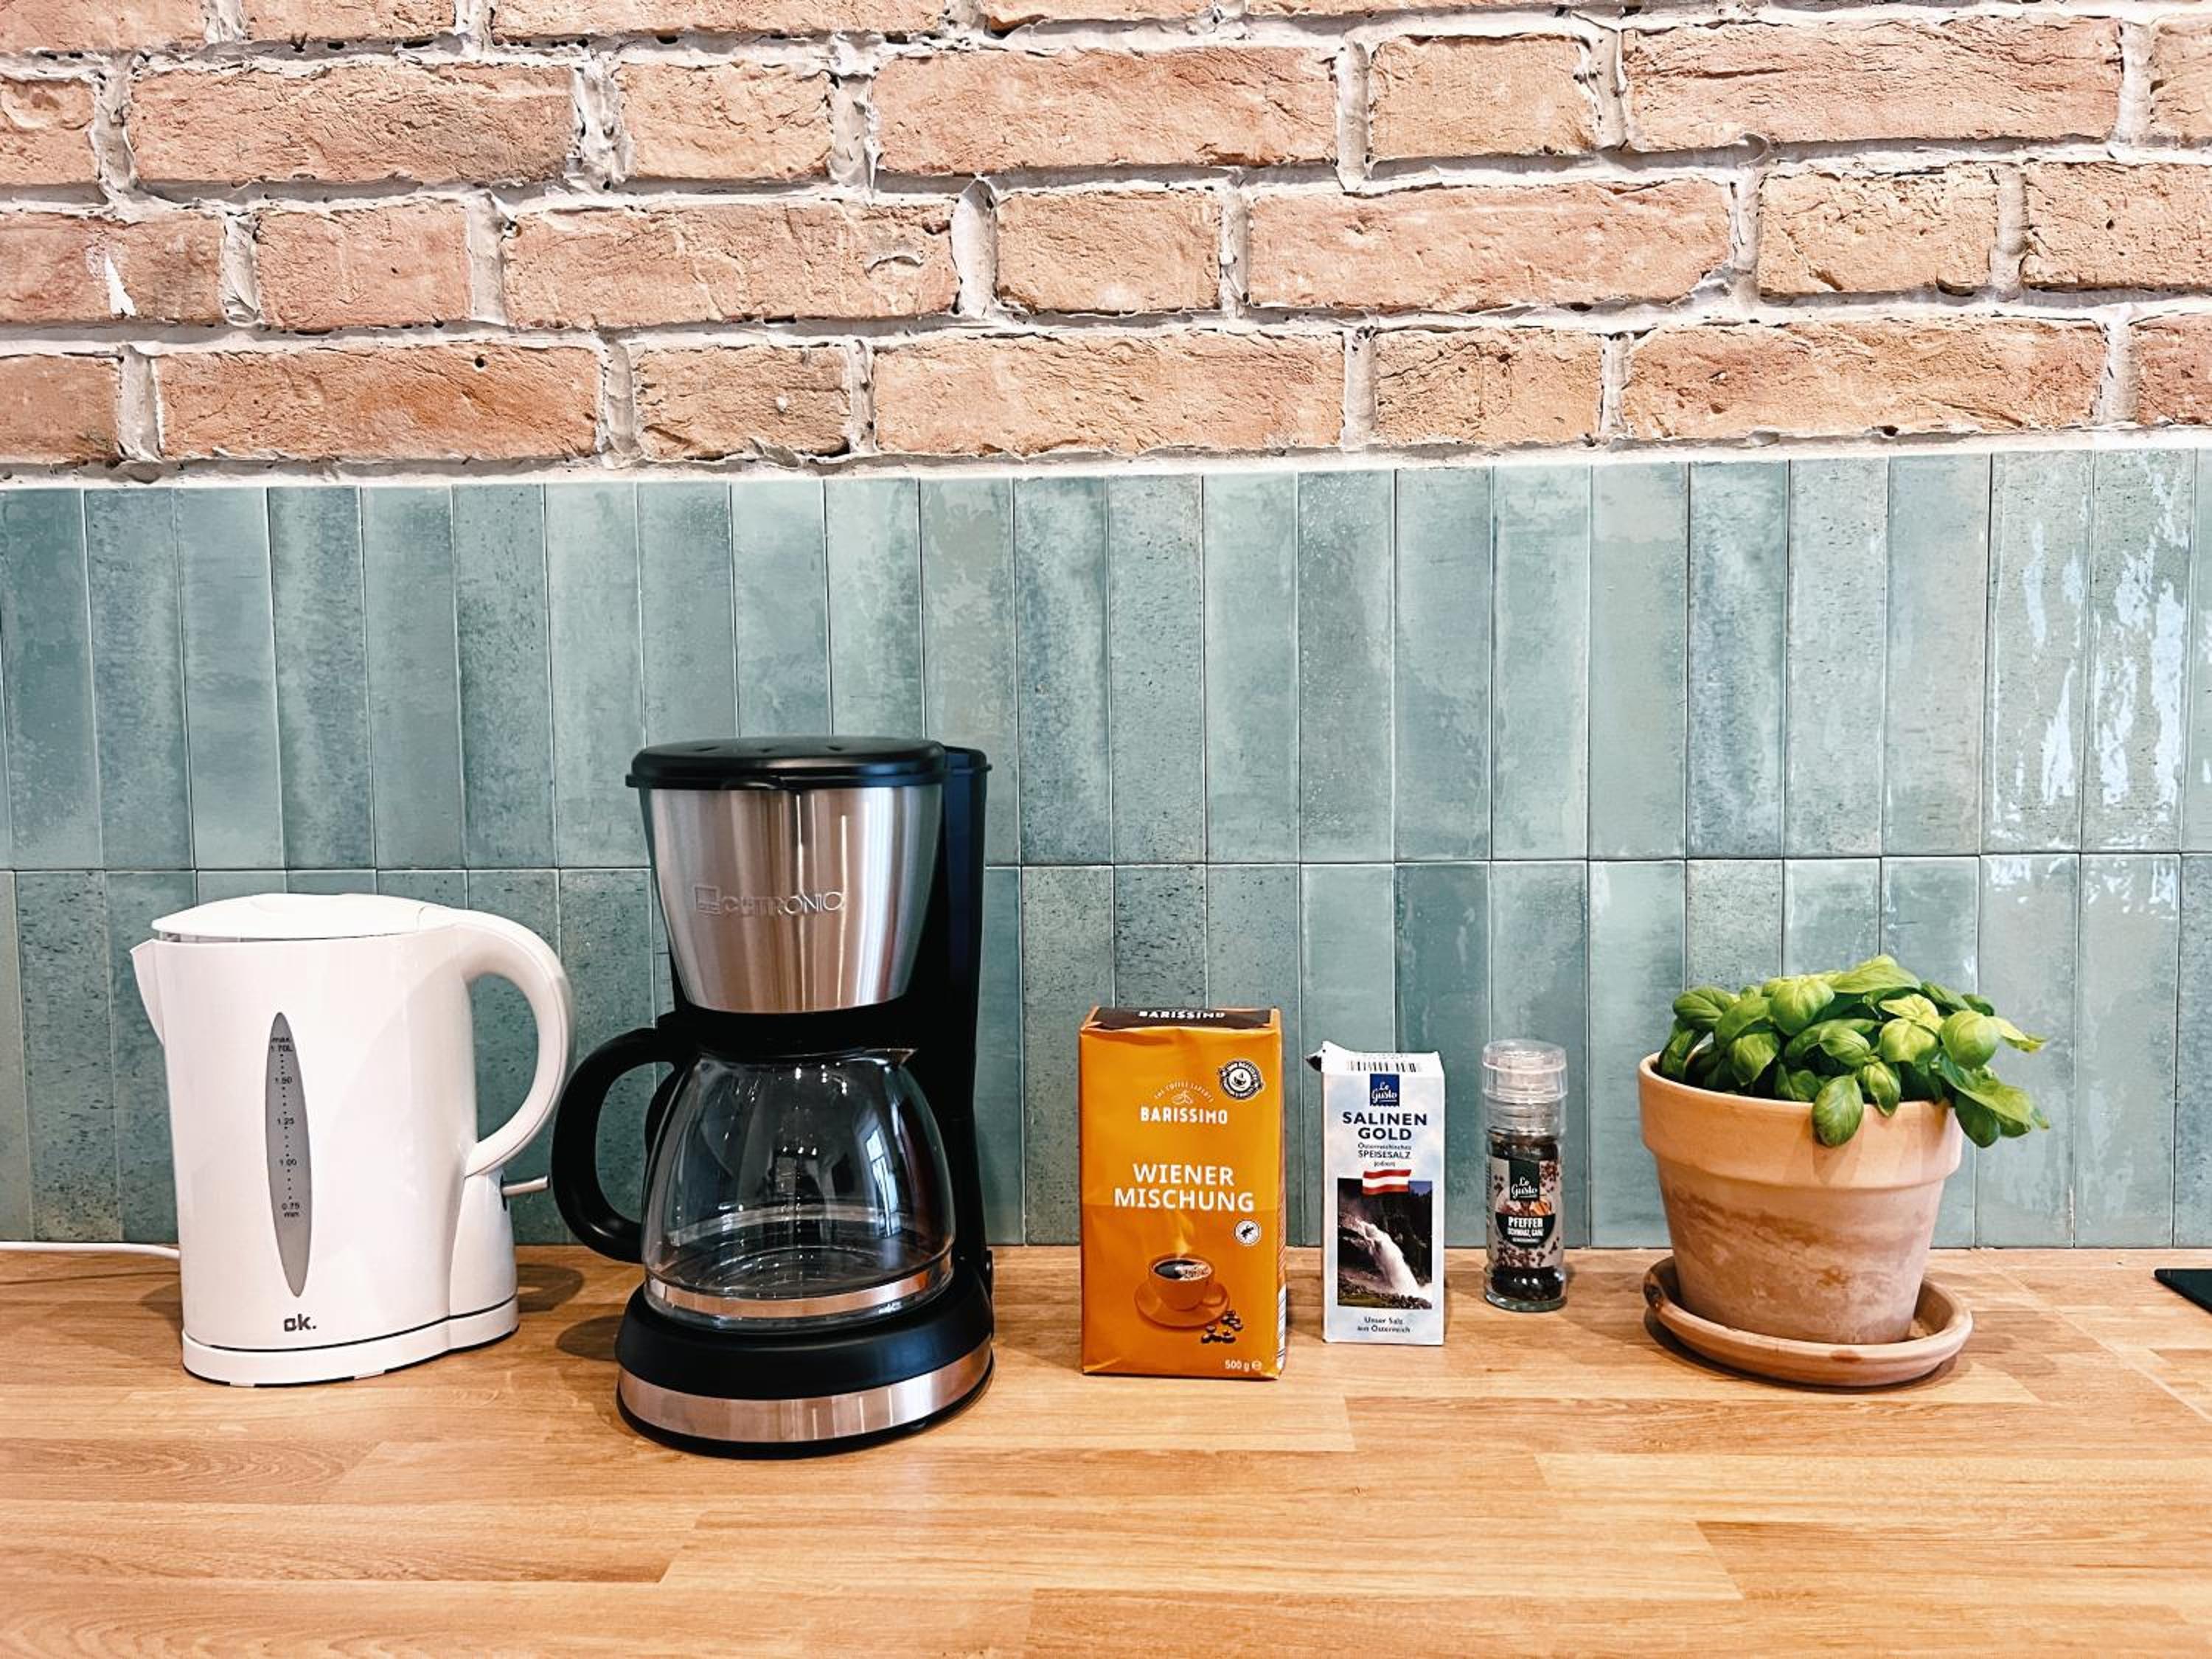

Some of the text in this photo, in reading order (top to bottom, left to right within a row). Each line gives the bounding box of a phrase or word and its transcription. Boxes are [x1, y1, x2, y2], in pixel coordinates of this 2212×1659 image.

[1371, 1082, 1397, 1104] Le Gusto
[1140, 1106, 1228, 1124] BARISSIMO
[1343, 1111, 1427, 1126] SALINEN
[1357, 1127, 1412, 1141] GOLD
[1357, 1150, 1411, 1159] SPEISESALZ
[1132, 1164, 1235, 1186] WIENER
[1512, 1176, 1538, 1199] Le Gusto
[1113, 1187, 1255, 1213] MISCHUNG
[1508, 1216, 1544, 1228] PFEFFER
[284, 1313, 317, 1332] ok.
[1225, 1359, 1251, 1373] 500 g
